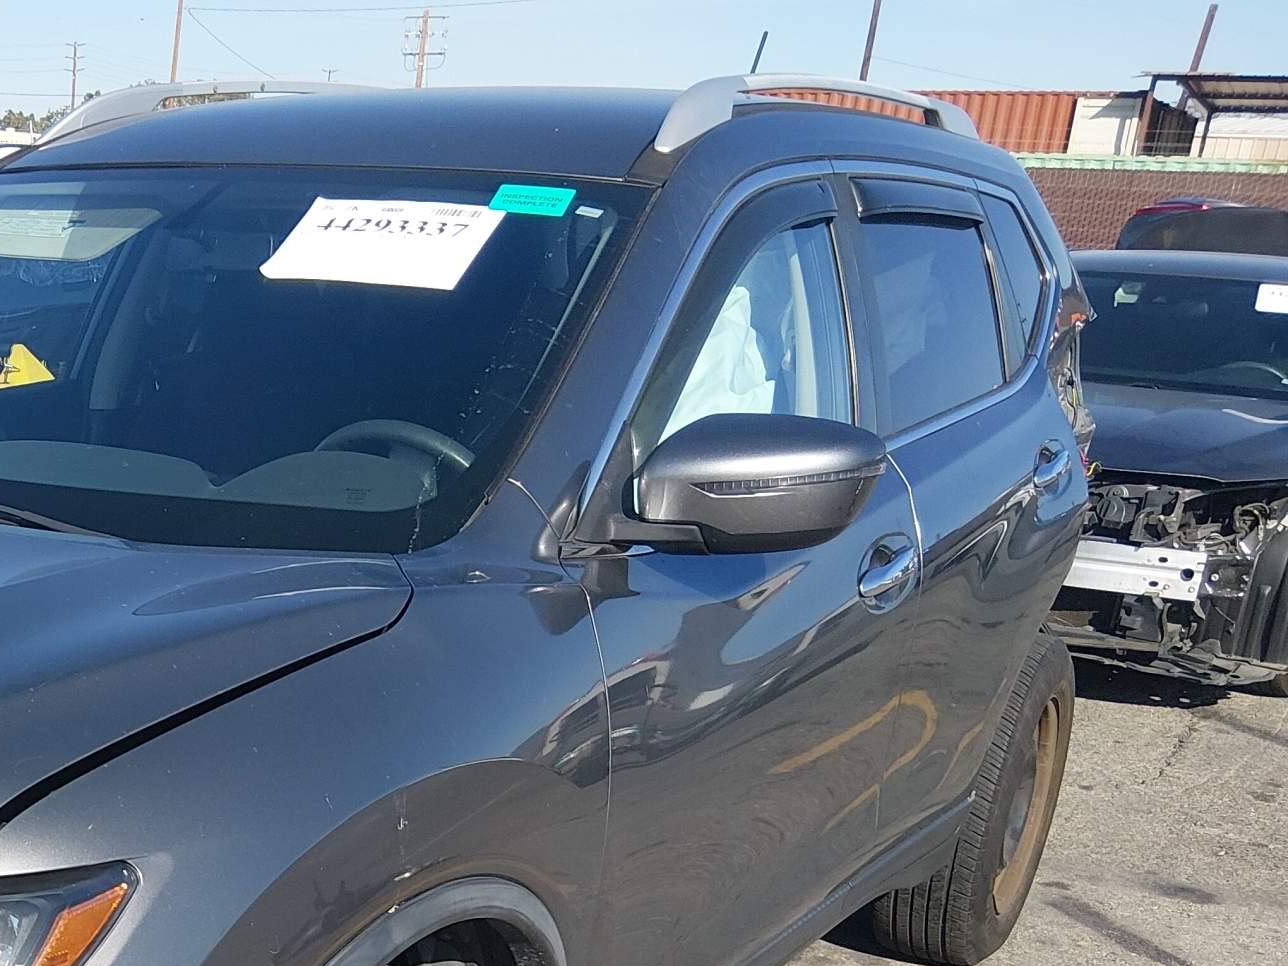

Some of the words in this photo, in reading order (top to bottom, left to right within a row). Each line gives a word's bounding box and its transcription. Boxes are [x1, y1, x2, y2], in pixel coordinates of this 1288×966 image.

[500, 192, 564, 203] INSPECTION
[502, 199, 559, 208] COMPLETE
[316, 216, 470, 237] 44293337
